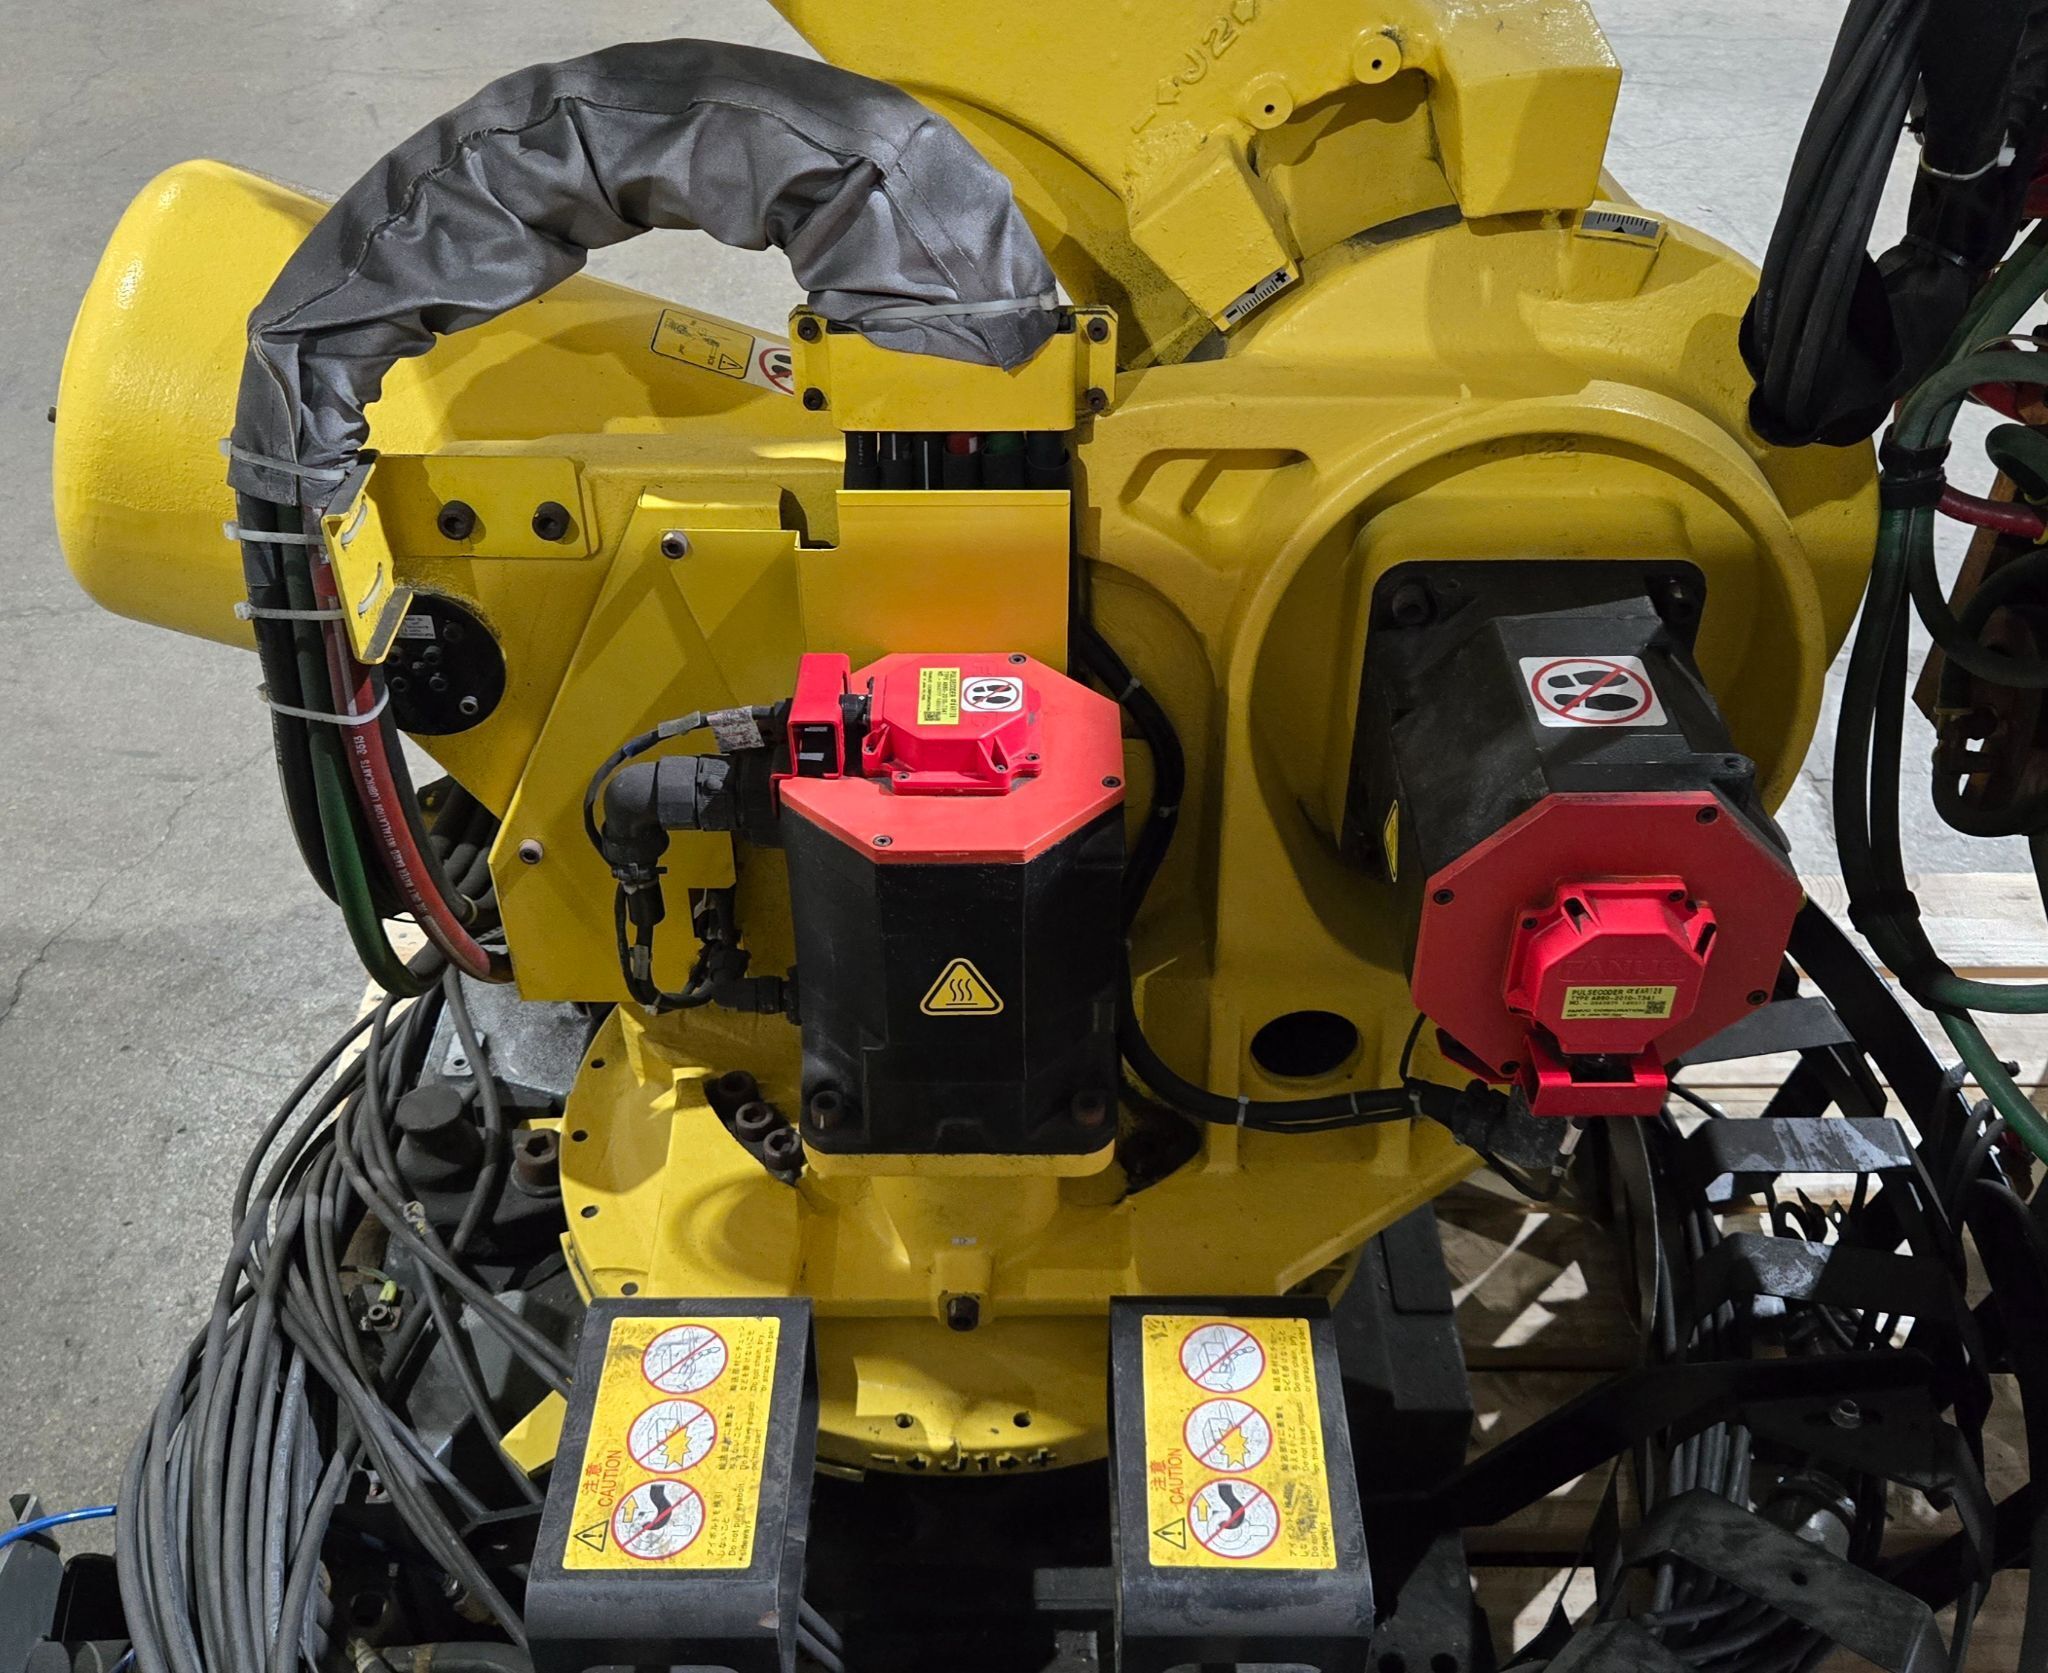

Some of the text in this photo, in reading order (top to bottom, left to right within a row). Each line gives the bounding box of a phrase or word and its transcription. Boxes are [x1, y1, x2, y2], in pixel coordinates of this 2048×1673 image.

[360, 759, 381, 802] LUBRICANTS
[581, 1462, 603, 1496] 注意
[597, 1449, 622, 1507] CAUTION
[1151, 1459, 1167, 1492] 注意
[1168, 1447, 1185, 1505] CAUTION
